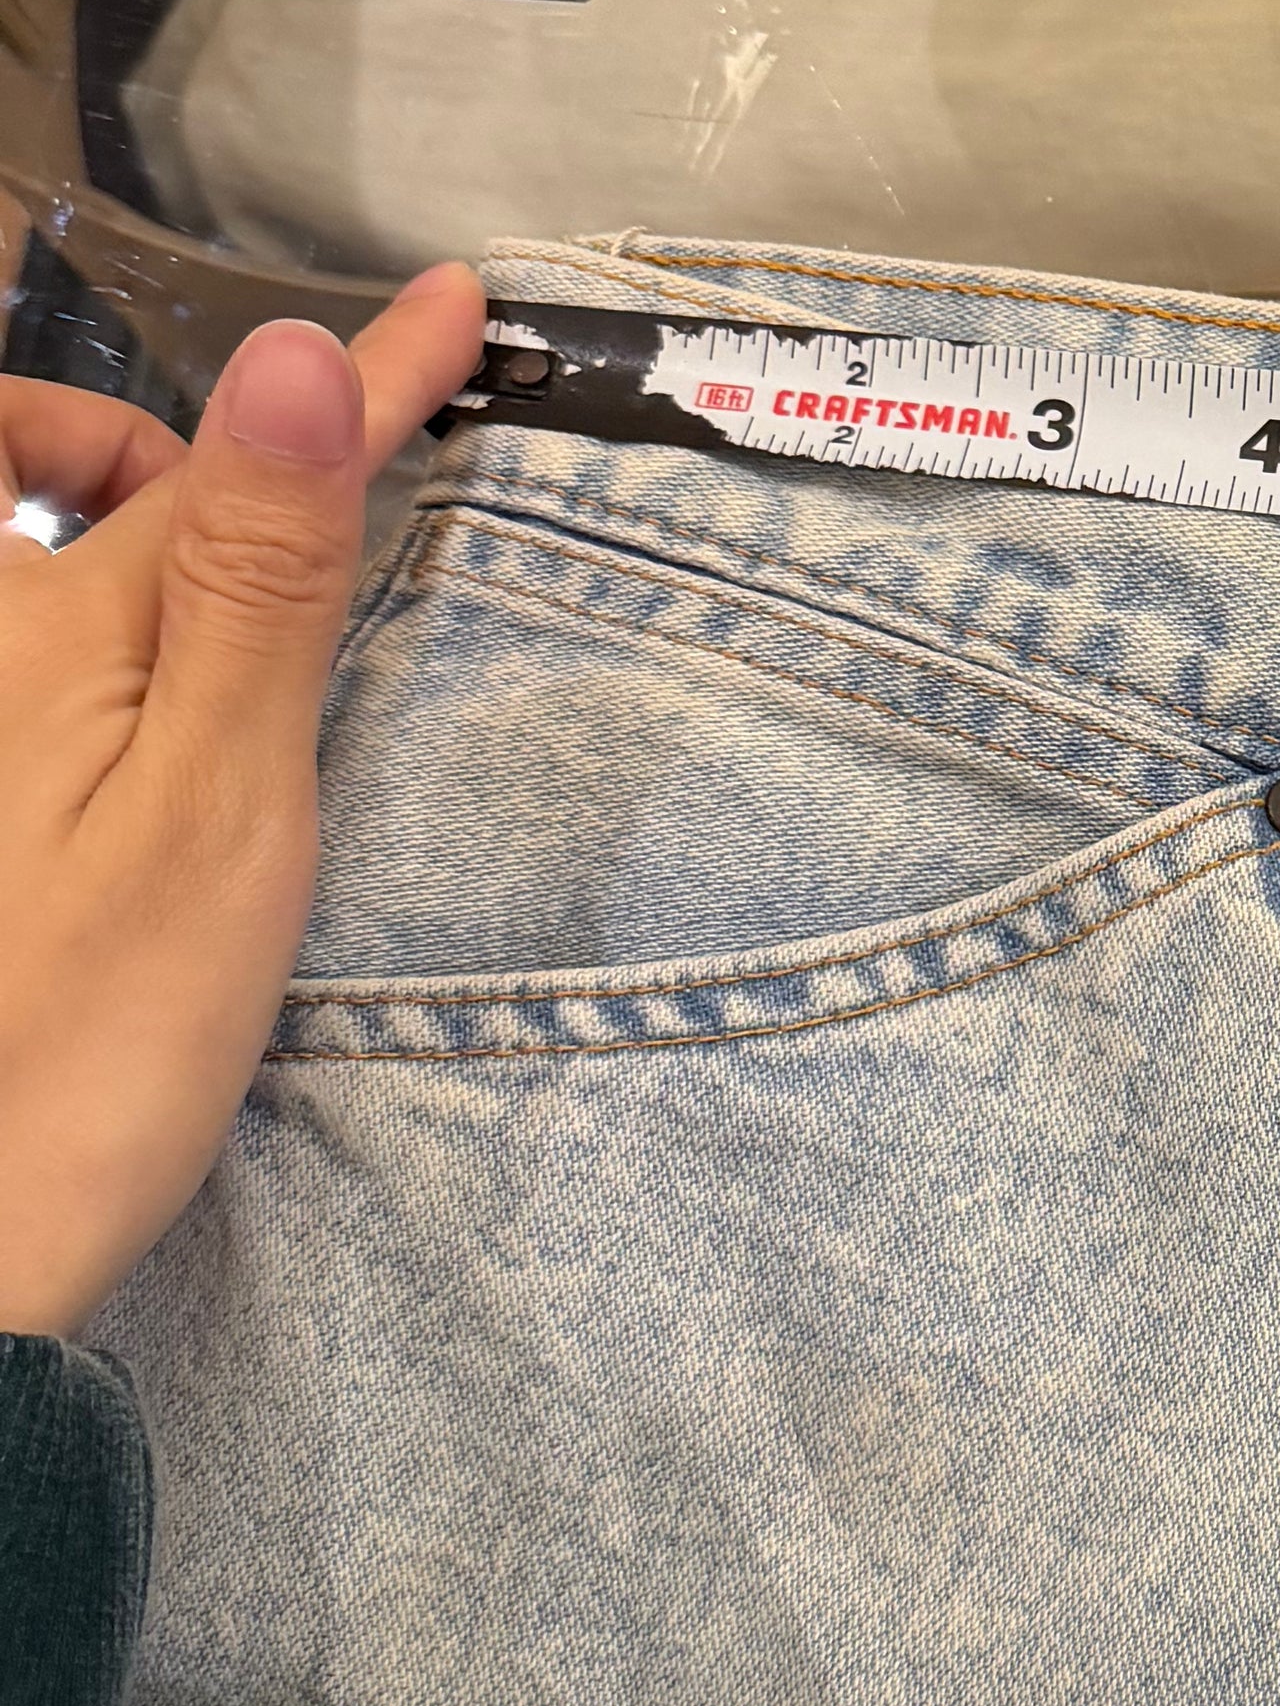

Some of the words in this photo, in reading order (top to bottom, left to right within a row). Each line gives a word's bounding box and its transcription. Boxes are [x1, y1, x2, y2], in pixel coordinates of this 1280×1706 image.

[844, 361, 868, 387] 2
[831, 425, 855, 445] 2
[1027, 398, 1076, 451] 3
